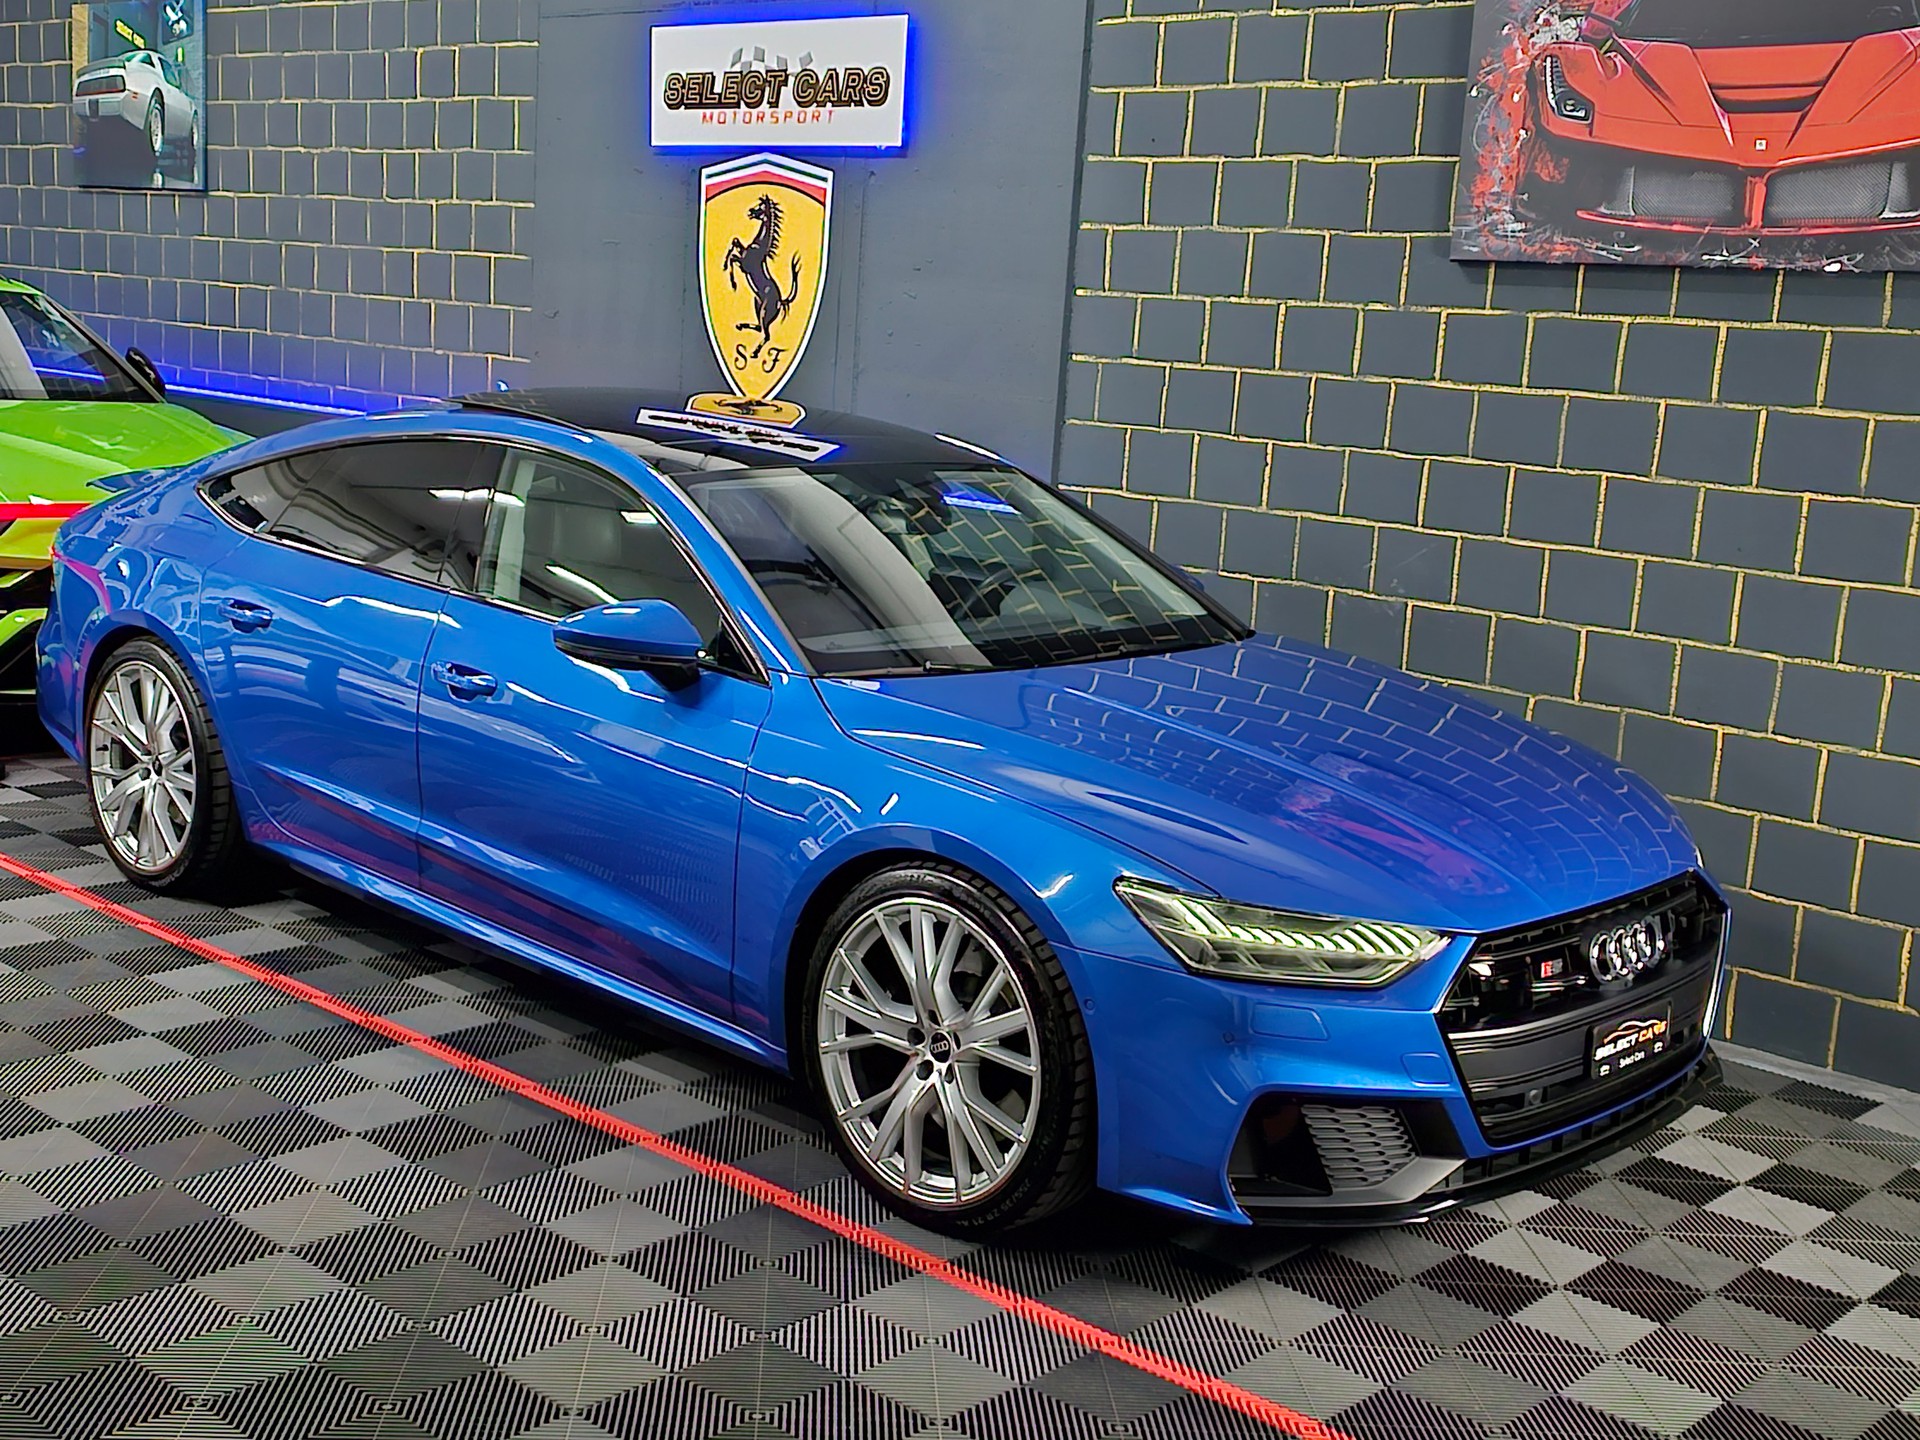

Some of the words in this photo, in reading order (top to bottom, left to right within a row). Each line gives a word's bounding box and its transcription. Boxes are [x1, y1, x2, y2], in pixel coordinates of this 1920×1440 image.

[664, 70, 789, 109] SELECT
[792, 66, 890, 108] CARS
[701, 109, 835, 125] MOTORSPORT
